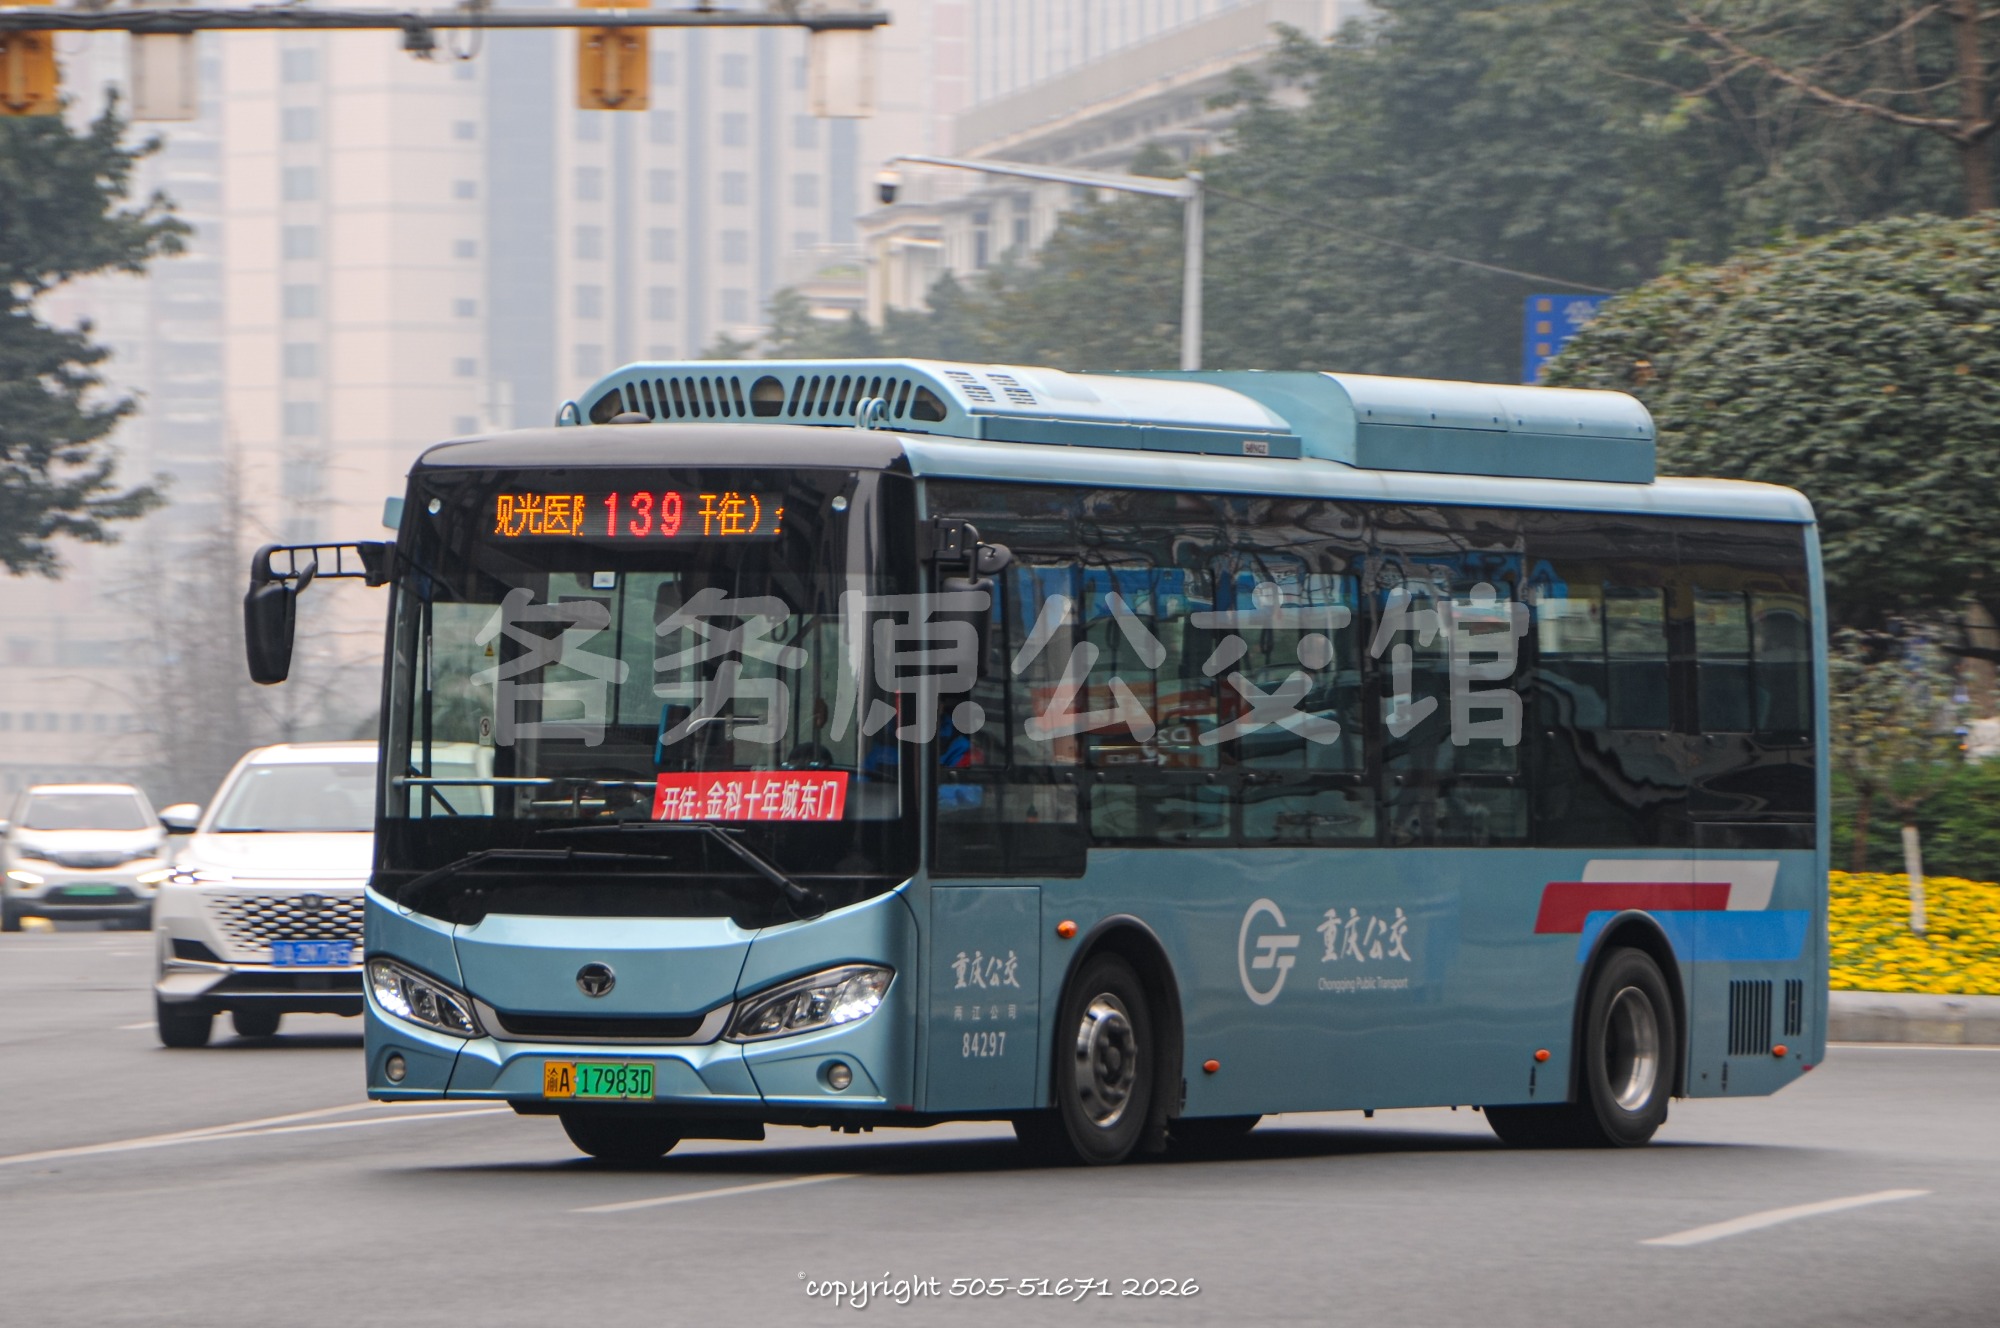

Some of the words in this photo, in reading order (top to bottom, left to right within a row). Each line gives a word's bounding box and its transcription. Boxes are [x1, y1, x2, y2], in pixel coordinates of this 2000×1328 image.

[604, 491, 682, 538] 139
[1316, 907, 1411, 963] 重庆公交
[951, 949, 1021, 989] 重庆公交
[962, 1031, 1006, 1058] 84297
